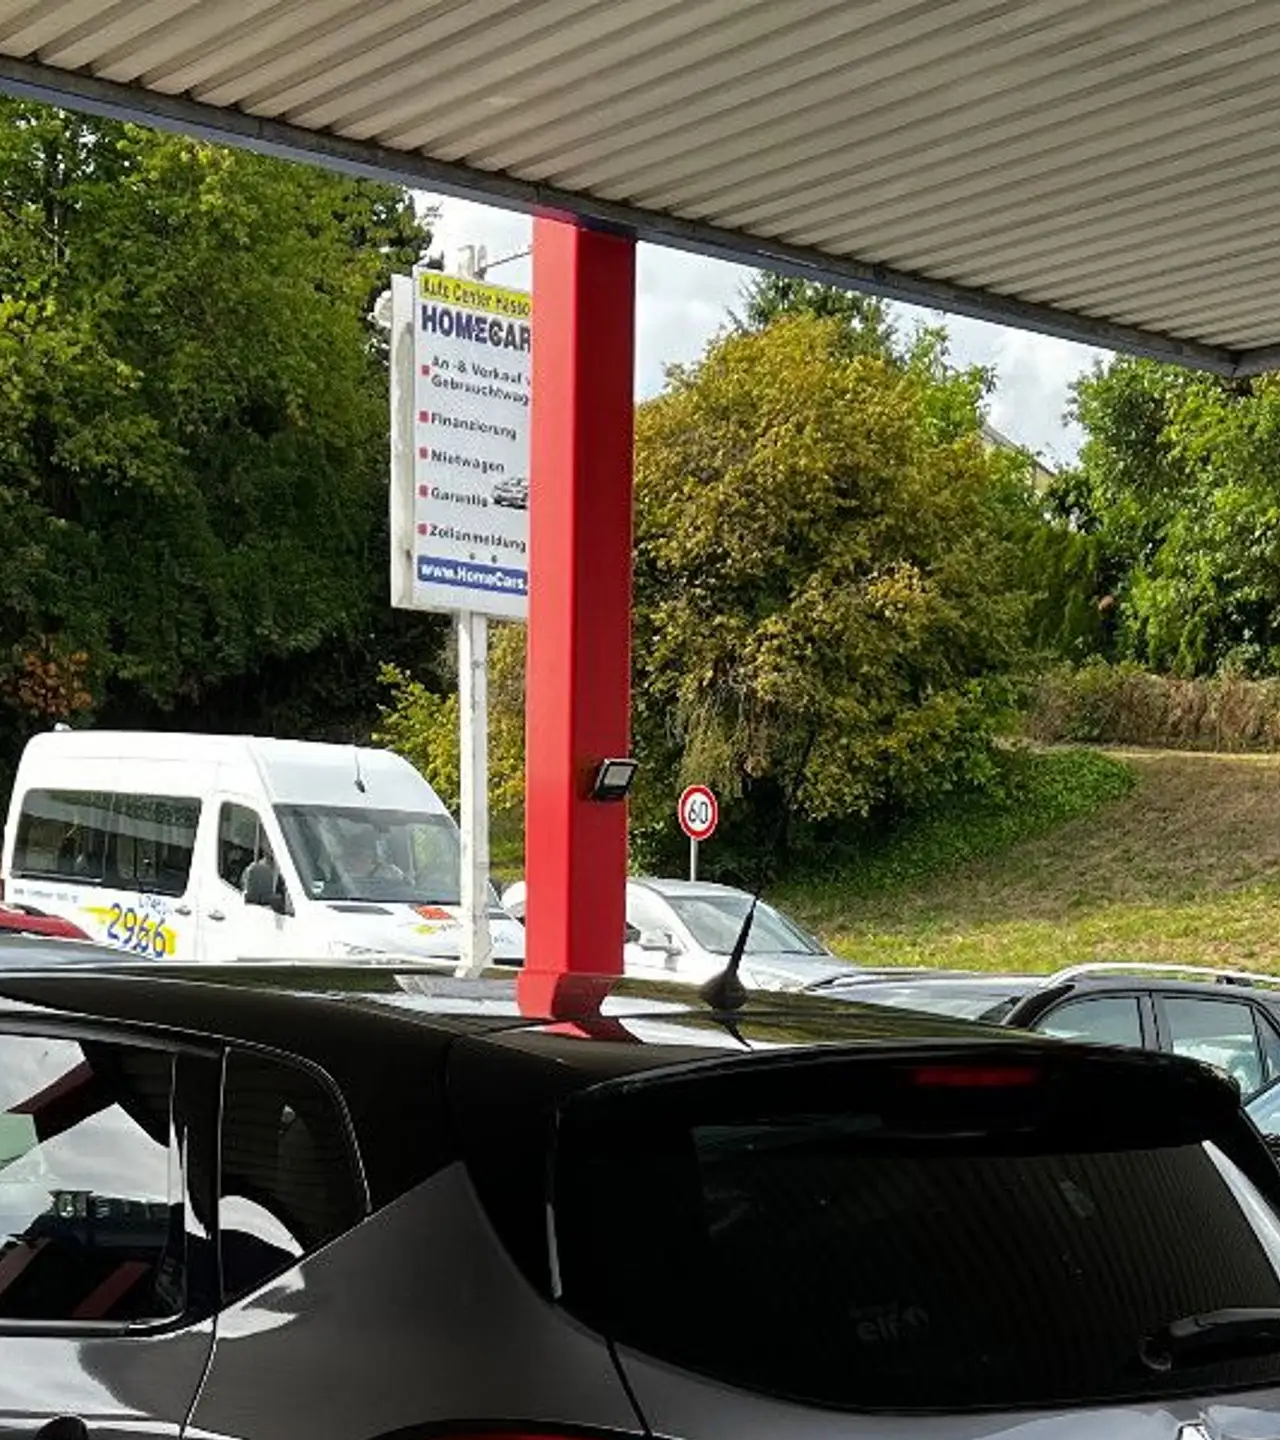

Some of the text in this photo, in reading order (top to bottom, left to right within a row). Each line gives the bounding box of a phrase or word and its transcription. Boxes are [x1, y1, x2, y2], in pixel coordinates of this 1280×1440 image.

[421, 305, 531, 353] HOMECAR
[431, 374, 530, 406] Gebrauchtwag
[431, 412, 517, 441] Finanzierung
[431, 450, 505, 474] Mietwagen
[431, 487, 488, 507] Garantie
[429, 523, 527, 553] Zollanmeldung
[420, 563, 527, 590] www.HomeCars.
[688, 799, 709, 825] 60
[107, 902, 166, 958] 2966
